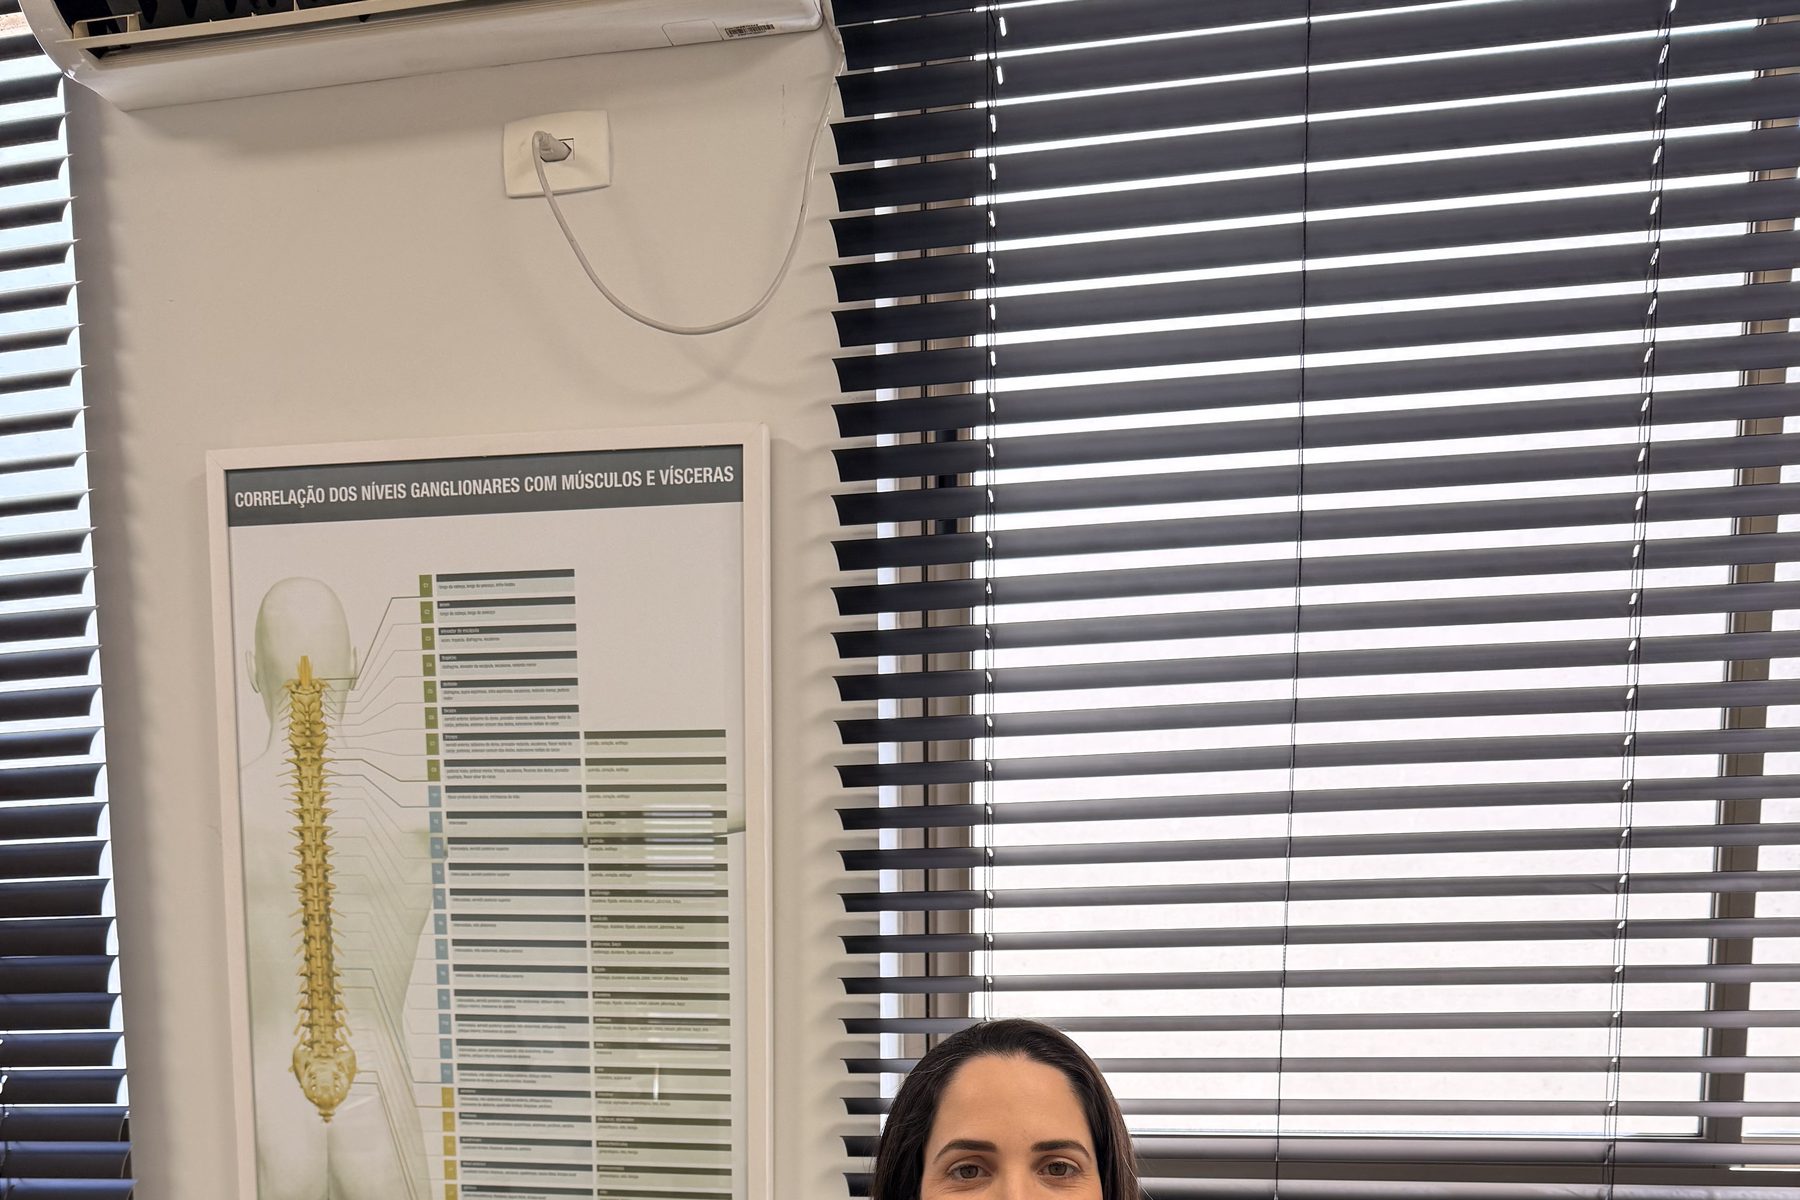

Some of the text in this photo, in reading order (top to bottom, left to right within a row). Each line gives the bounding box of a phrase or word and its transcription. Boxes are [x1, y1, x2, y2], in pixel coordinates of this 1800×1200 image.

[234, 465, 734, 509] CORRELAÇÃO DOS NÍVEIS GANGLIONARES COM MÚSCULOS E VÍSCERAS
